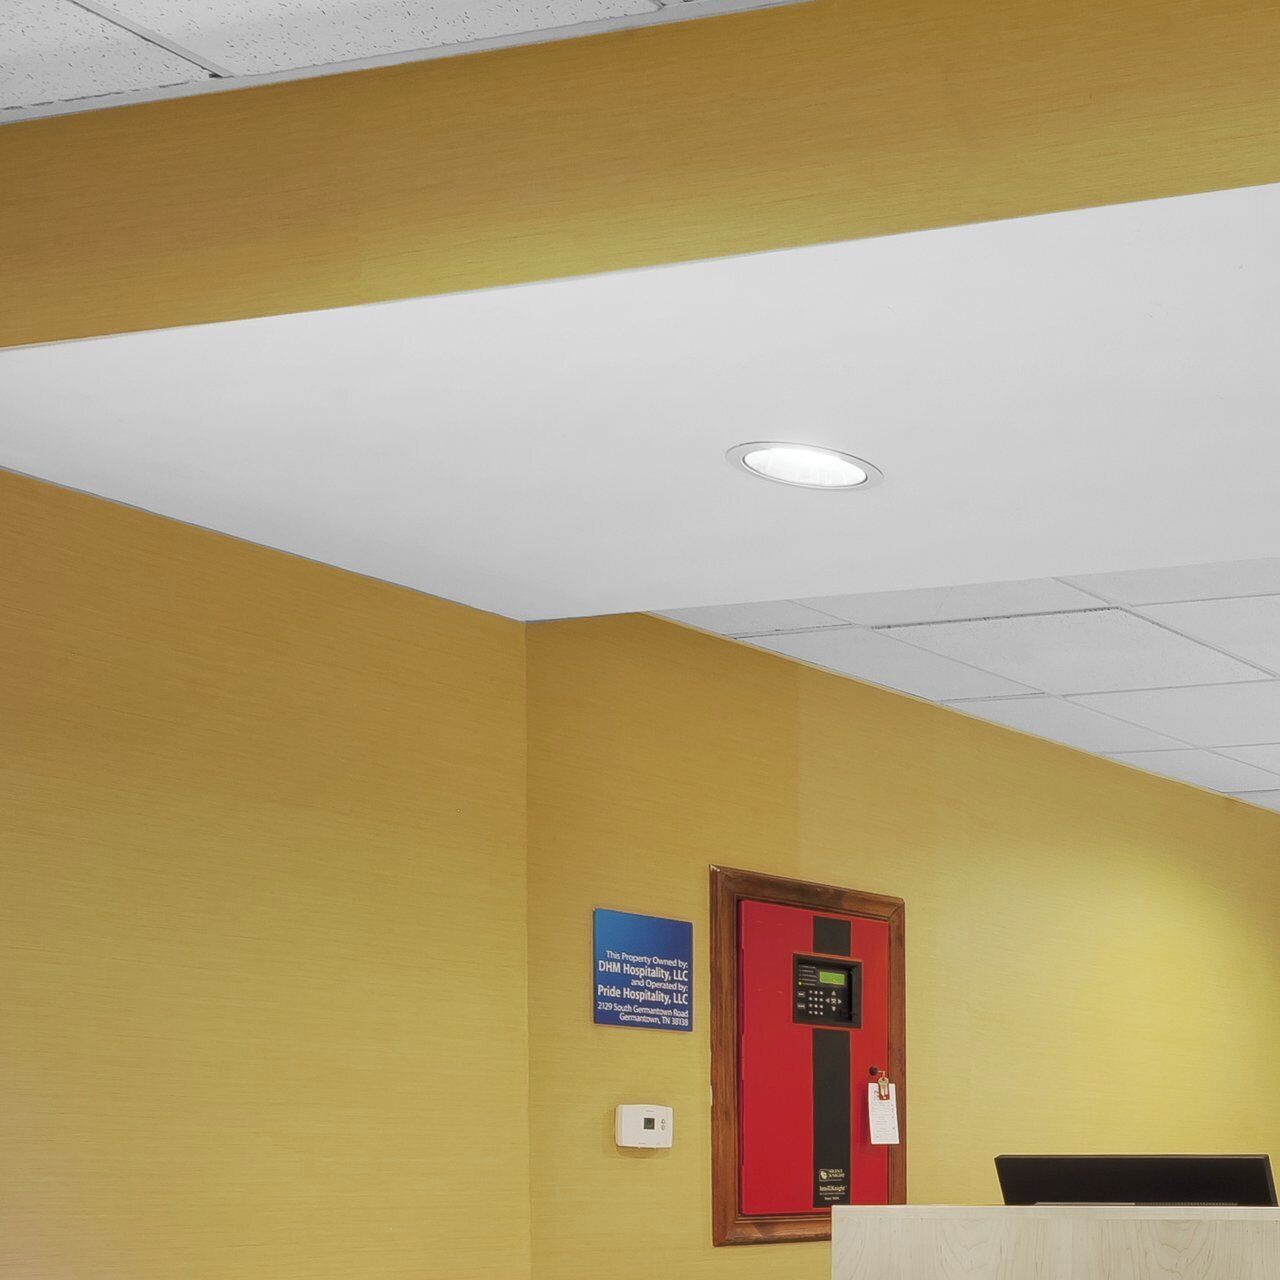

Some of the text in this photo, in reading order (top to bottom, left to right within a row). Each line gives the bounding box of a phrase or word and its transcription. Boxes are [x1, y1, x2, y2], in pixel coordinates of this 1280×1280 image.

[606, 950, 688, 969] This Property Owned by:
[598, 960, 688, 981] DHM Hospitality, LLC
[597, 984, 688, 1005] Pride Hospitality, LLC
[630, 979, 688, 992] and Operated by:
[597, 1001, 689, 1018] 2129 South Germantown Road
[619, 1012, 661, 1024] Germantown,
[662, 1016, 671, 1024] TN
